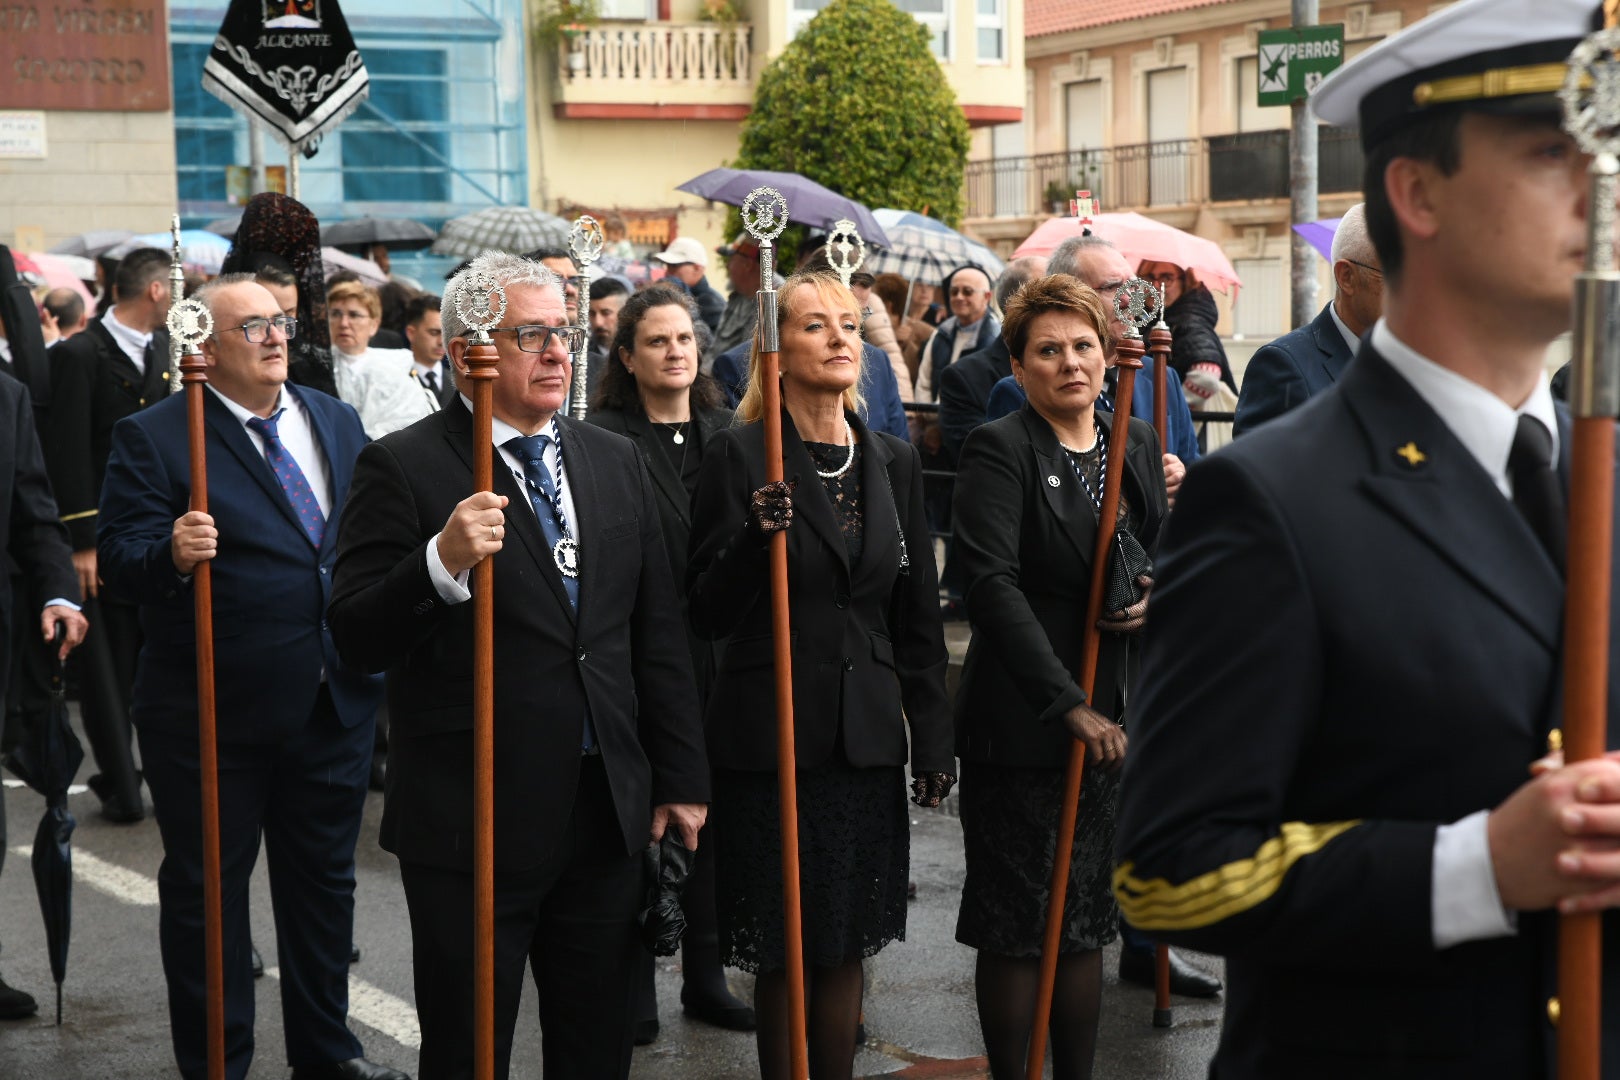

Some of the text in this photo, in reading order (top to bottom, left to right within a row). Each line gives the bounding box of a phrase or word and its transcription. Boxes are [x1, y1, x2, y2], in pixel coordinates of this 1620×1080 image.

[54, 6, 154, 35] VIRGEN
[254, 33, 333, 49] ALICANTE
[1288, 39, 1340, 60] PERROS
[14, 55, 146, 84] SOCORRO
